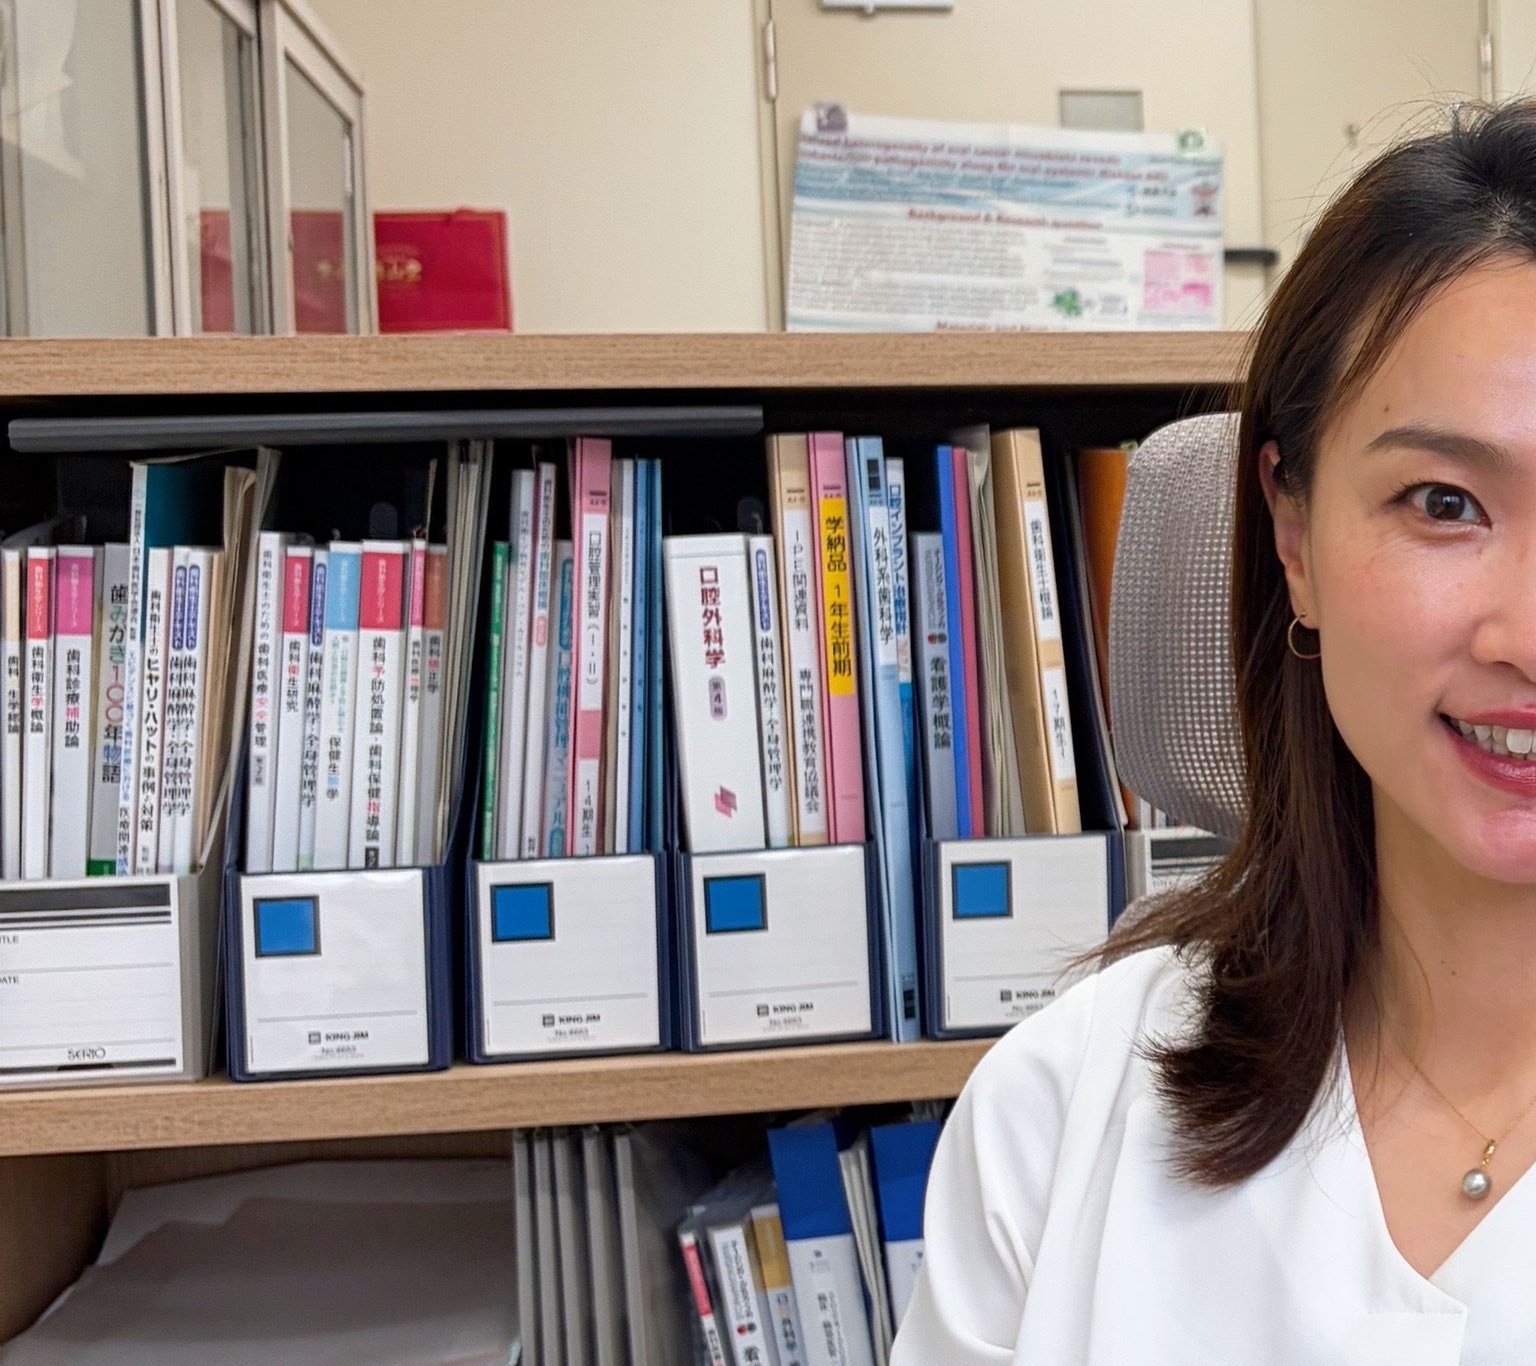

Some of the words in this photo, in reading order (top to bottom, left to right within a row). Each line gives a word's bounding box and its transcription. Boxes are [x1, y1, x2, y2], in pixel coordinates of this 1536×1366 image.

[699, 566, 726, 670] 口腔外科学
[930, 657, 952, 750] 看護学概論
